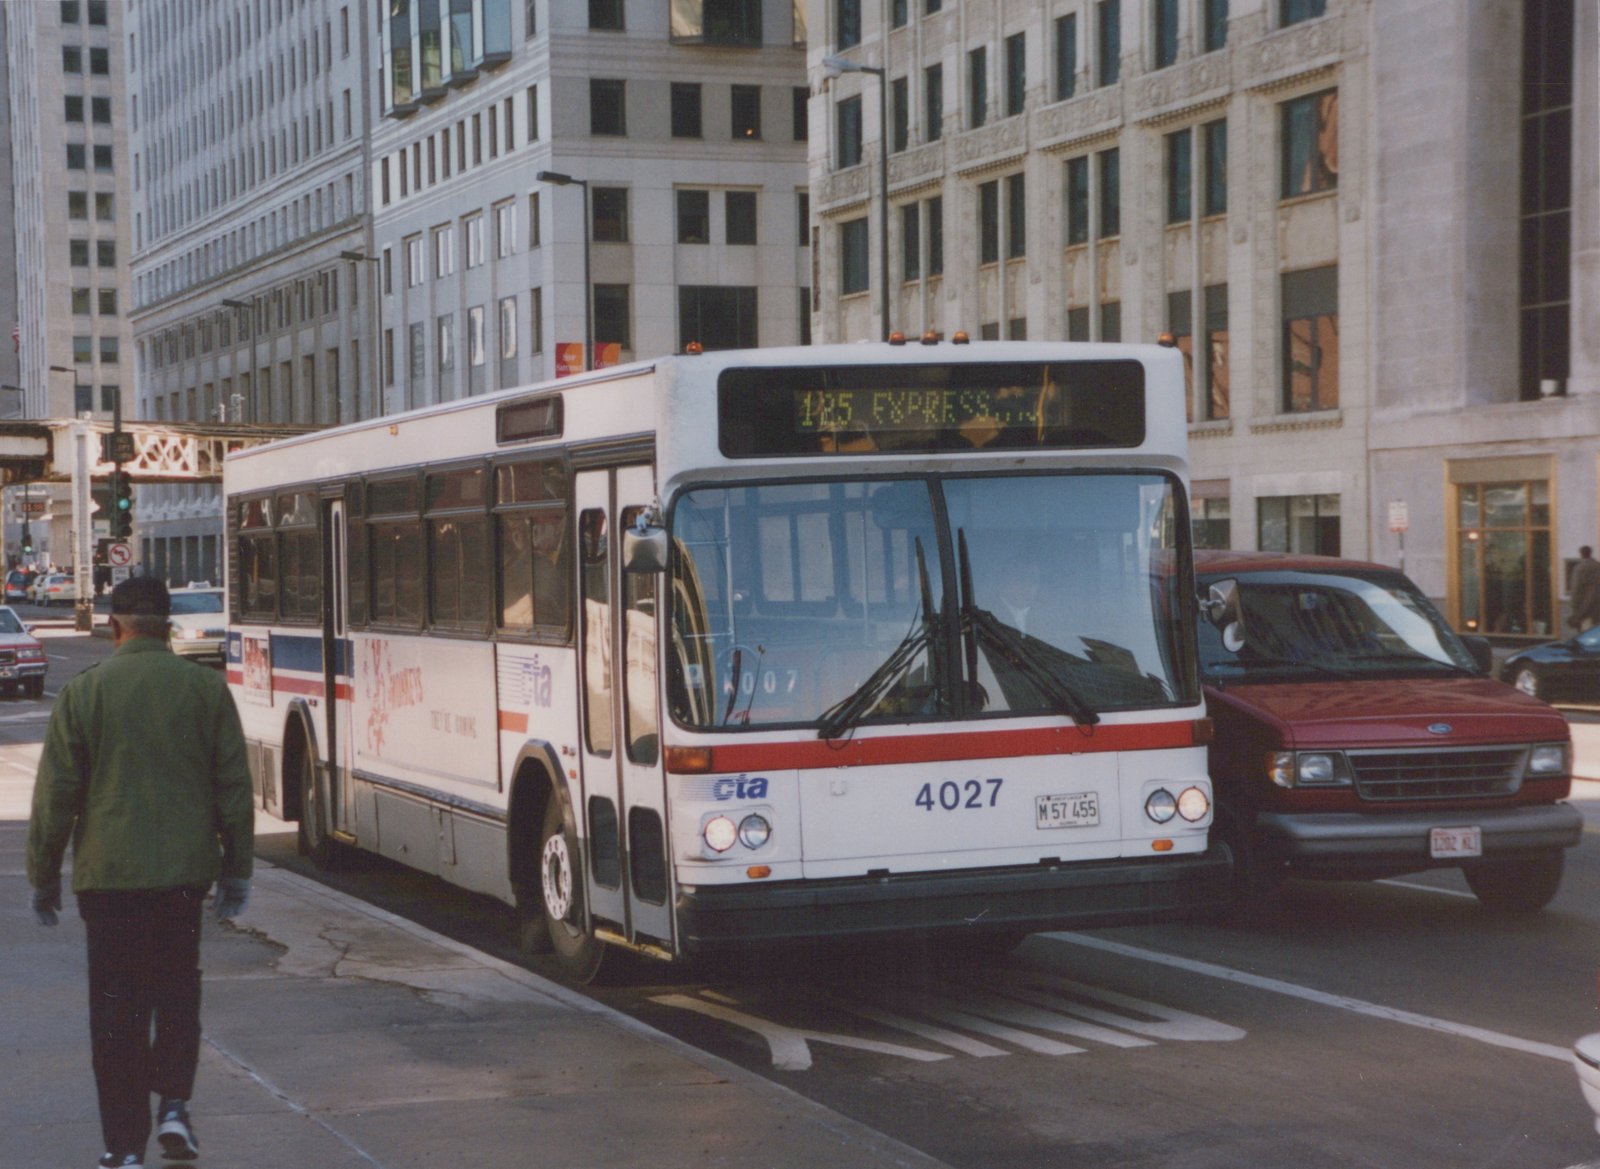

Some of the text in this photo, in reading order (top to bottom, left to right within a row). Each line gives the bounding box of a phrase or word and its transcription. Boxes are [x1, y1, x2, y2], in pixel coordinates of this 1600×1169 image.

[801, 390, 990, 427] 125 EXPRESS
[713, 772, 768, 801] cta
[914, 778, 1004, 812] 4027
[1039, 800, 1097, 821] M 57 455
